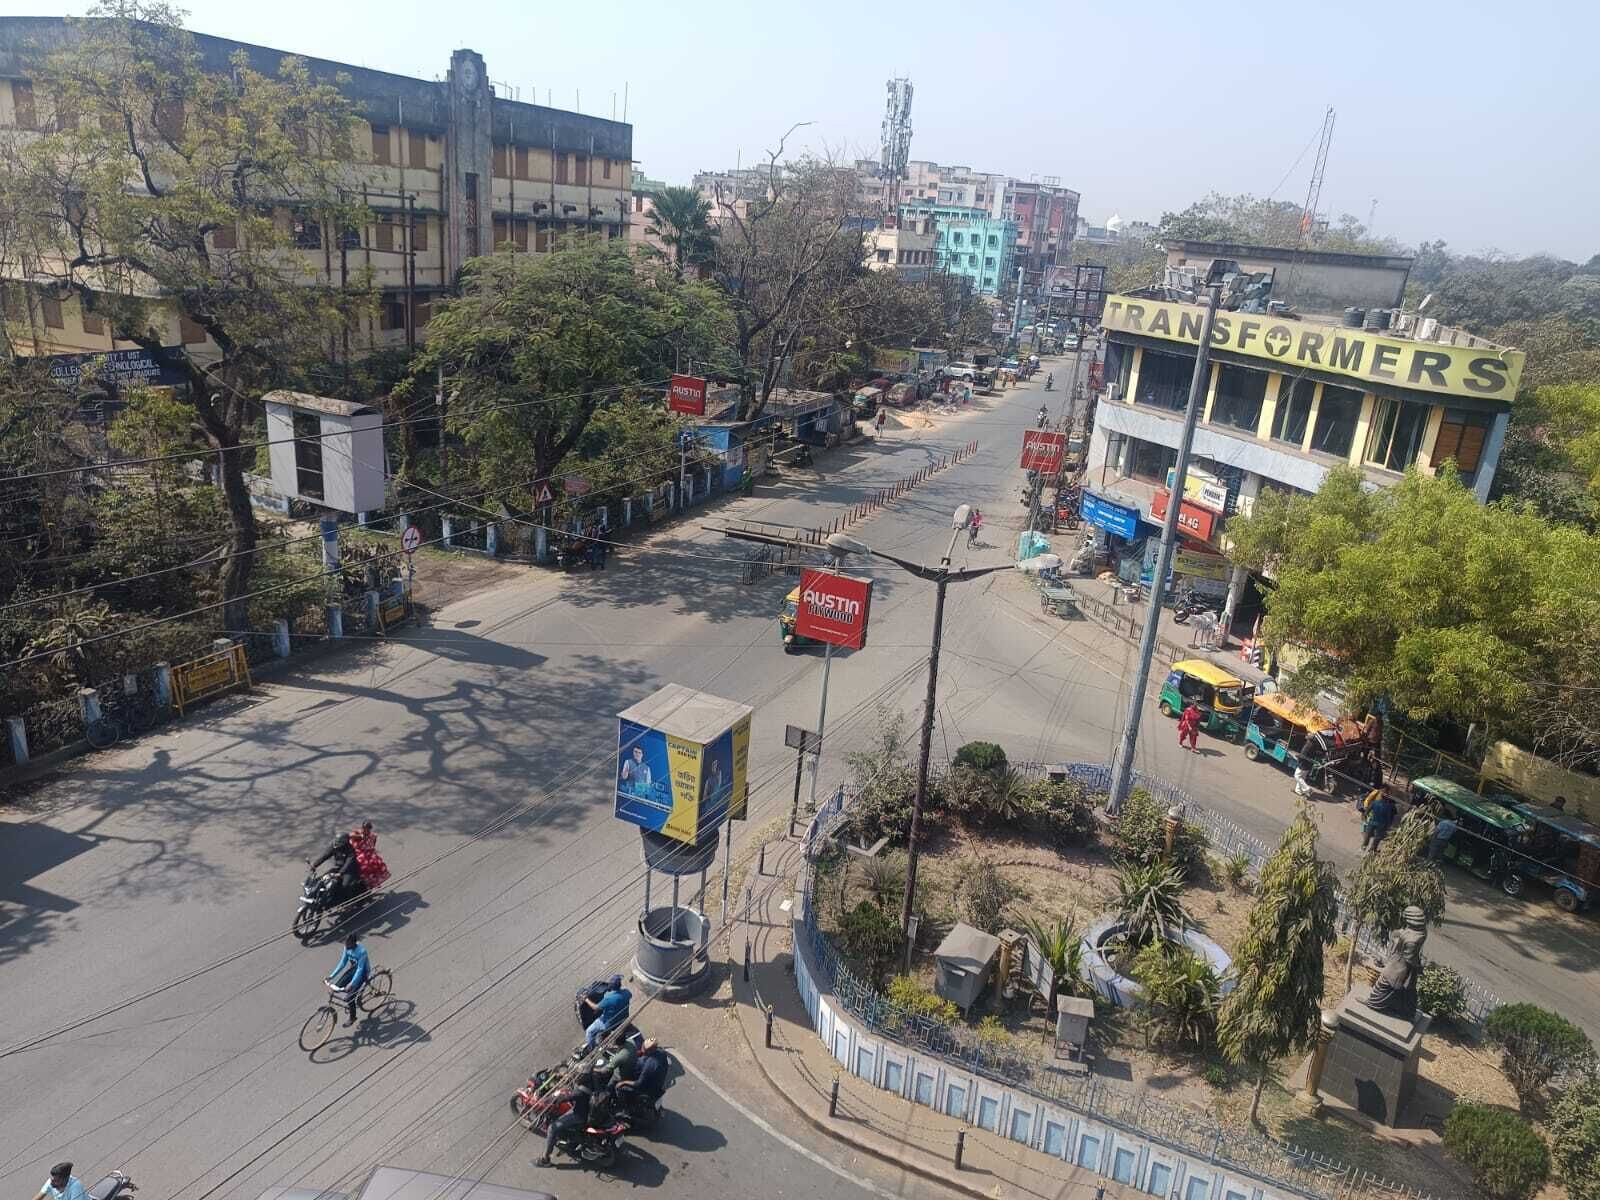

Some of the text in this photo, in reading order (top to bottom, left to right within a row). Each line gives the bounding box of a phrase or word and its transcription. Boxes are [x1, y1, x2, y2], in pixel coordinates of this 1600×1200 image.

[1108, 302, 1511, 393] TRANSFORMERS
[672, 386, 701, 398] AUSTIN
[1187, 516, 1199, 529] 4G
[803, 590, 860, 615] AUSTIN
[807, 603, 854, 624] PLYWOOD
